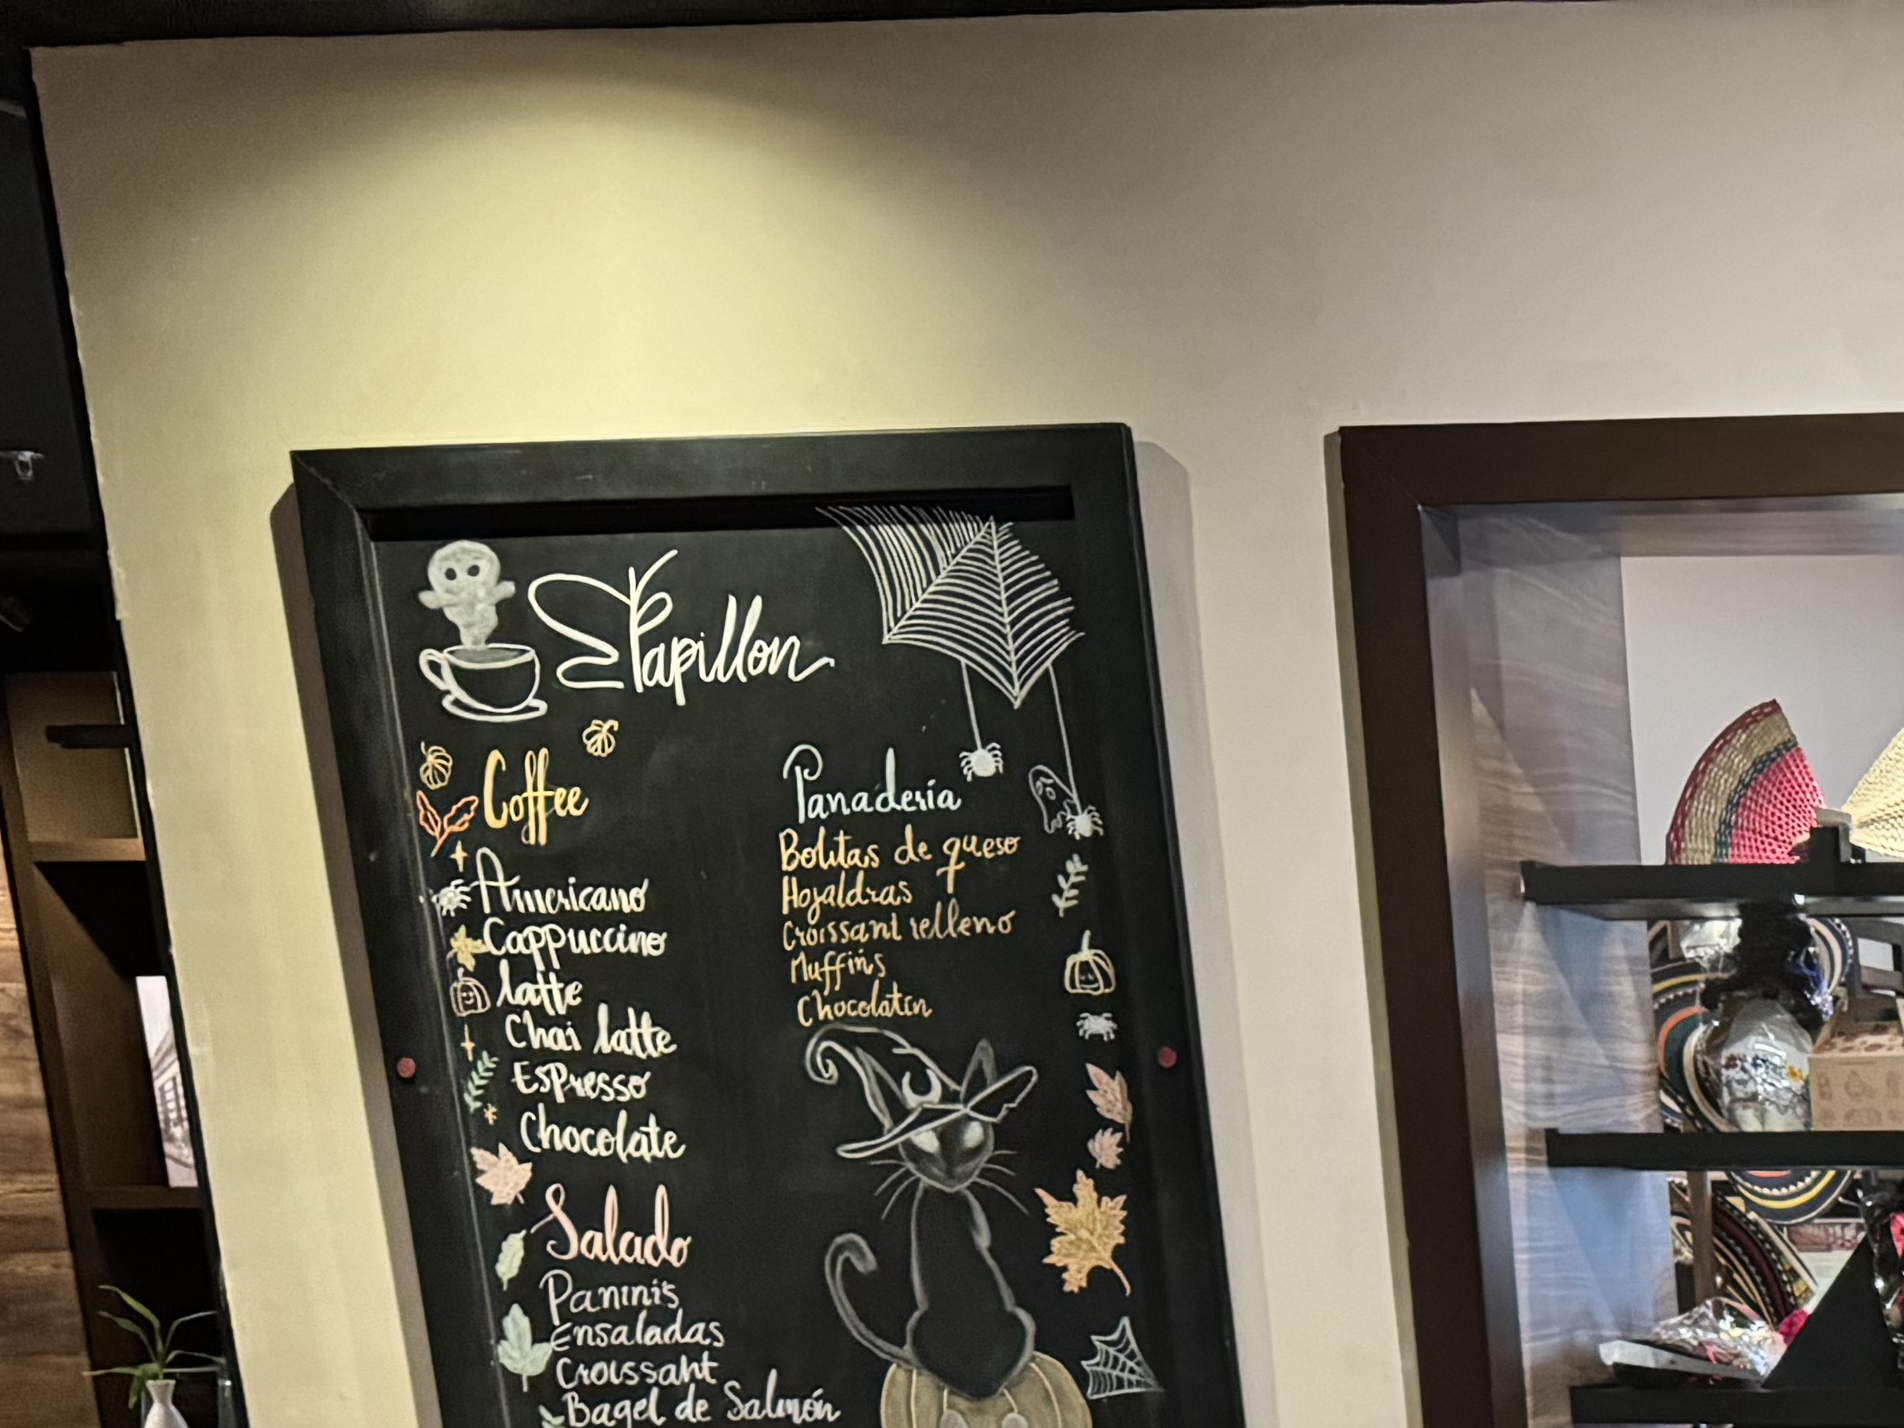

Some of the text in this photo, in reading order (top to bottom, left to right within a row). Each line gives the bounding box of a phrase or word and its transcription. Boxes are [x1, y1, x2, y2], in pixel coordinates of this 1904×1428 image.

[528, 549, 836, 706] Papillon
[483, 747, 590, 846] Coffee
[470, 847, 649, 915] Americano
[779, 823, 1021, 894] Bolitas de queso
[782, 870, 913, 924] Hojaldras
[910, 898, 1016, 940] relleno
[483, 917, 667, 971] Cappuccino
[790, 949, 886, 996] Muffins
[505, 1010, 582, 1051] Chai
[520, 1102, 687, 1164] Chocolate
[531, 1183, 692, 1268] Salado
[550, 1308, 725, 1352] Ensaladas
[556, 1351, 719, 1390] Croissant
[674, 1383, 712, 1424] de
